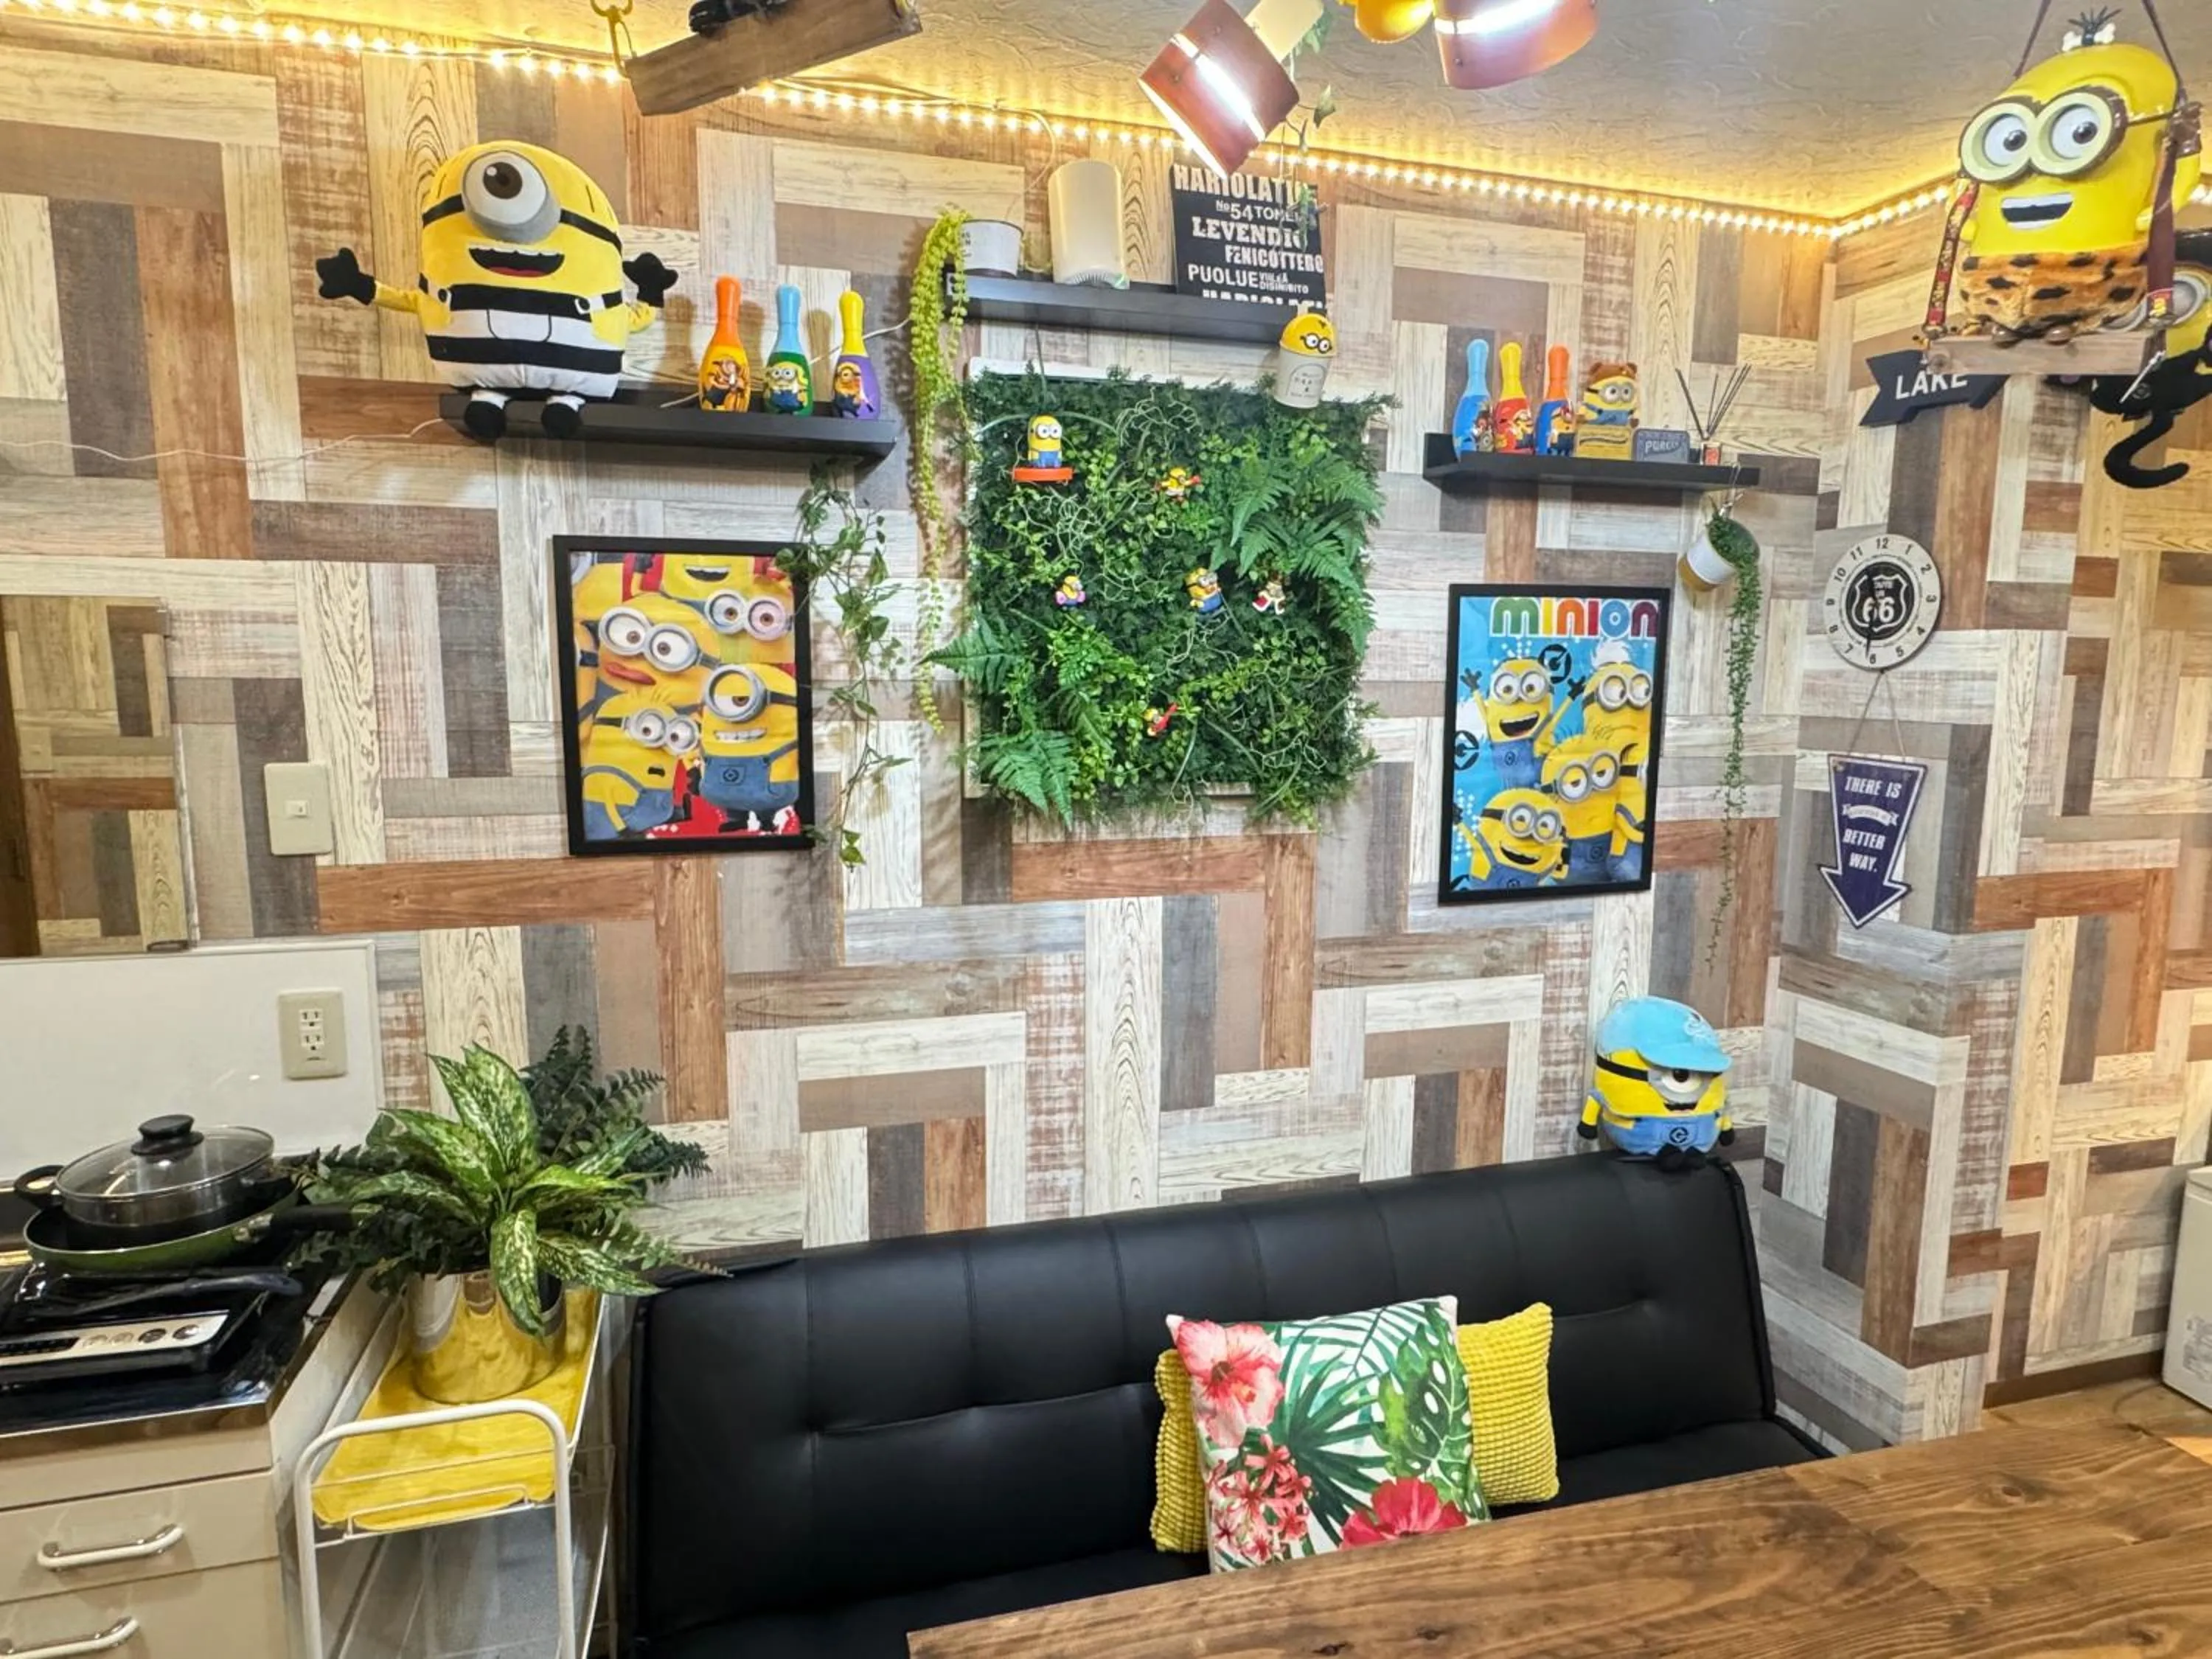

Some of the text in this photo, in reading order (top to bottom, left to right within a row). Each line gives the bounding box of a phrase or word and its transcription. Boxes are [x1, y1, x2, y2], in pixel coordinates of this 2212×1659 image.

[1172, 162, 1313, 206] HARIOLATU
[1188, 263, 1259, 288] PUOLUE
[1895, 370, 1968, 400] LAKE
[1876, 537, 1889, 549] 12
[1850, 546, 1863, 560] 11
[1834, 567, 1847, 582] 10
[1920, 564, 1932, 574] 2
[1826, 598, 1835, 606] 9
[1925, 594, 1937, 603] 3
[1863, 597, 1894, 622] 66
[1843, 642, 1854, 655] 7
[1895, 646, 1905, 658] 5
[1869, 653, 1877, 664] 6
[1845, 776, 1902, 799] THERE IS
[1843, 828, 1886, 850] BETTER
[1849, 852, 1878, 873] WAY.
